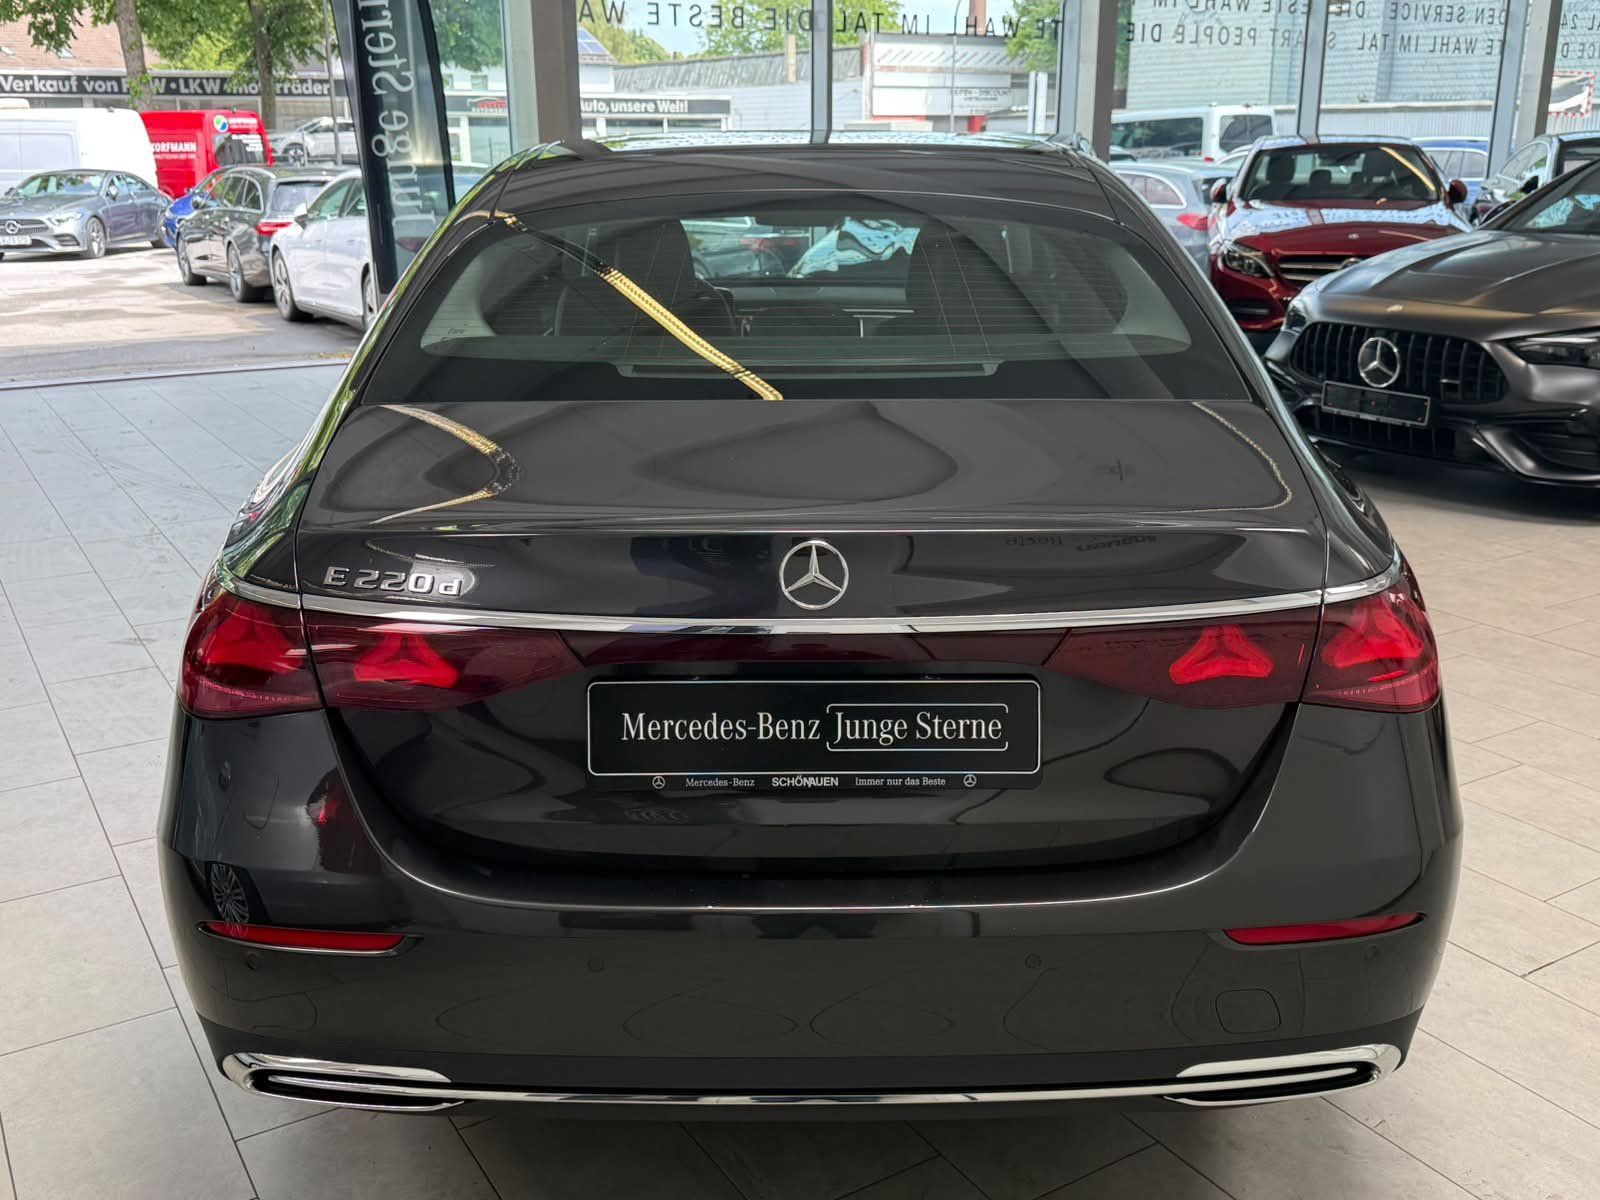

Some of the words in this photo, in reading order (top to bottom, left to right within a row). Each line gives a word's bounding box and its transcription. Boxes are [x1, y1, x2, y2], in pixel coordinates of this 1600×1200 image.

[0, 75, 78, 92] Verkauf
[82, 79, 119, 92] von
[178, 78, 222, 94] LKW
[611, 101, 656, 113] unsere
[323, 566, 350, 586] E
[620, 711, 822, 741] Mercedes-Benz
[833, 711, 909, 747] Junge
[915, 711, 1003, 741] Sterne
[685, 777, 756, 788] Mercedes-Benz
[770, 774, 839, 788] SCHÖNAUEN
[855, 776, 885, 786] Immer
[886, 777, 903, 786] nur
[904, 776, 921, 786] das
[922, 776, 947, 786] Beste
